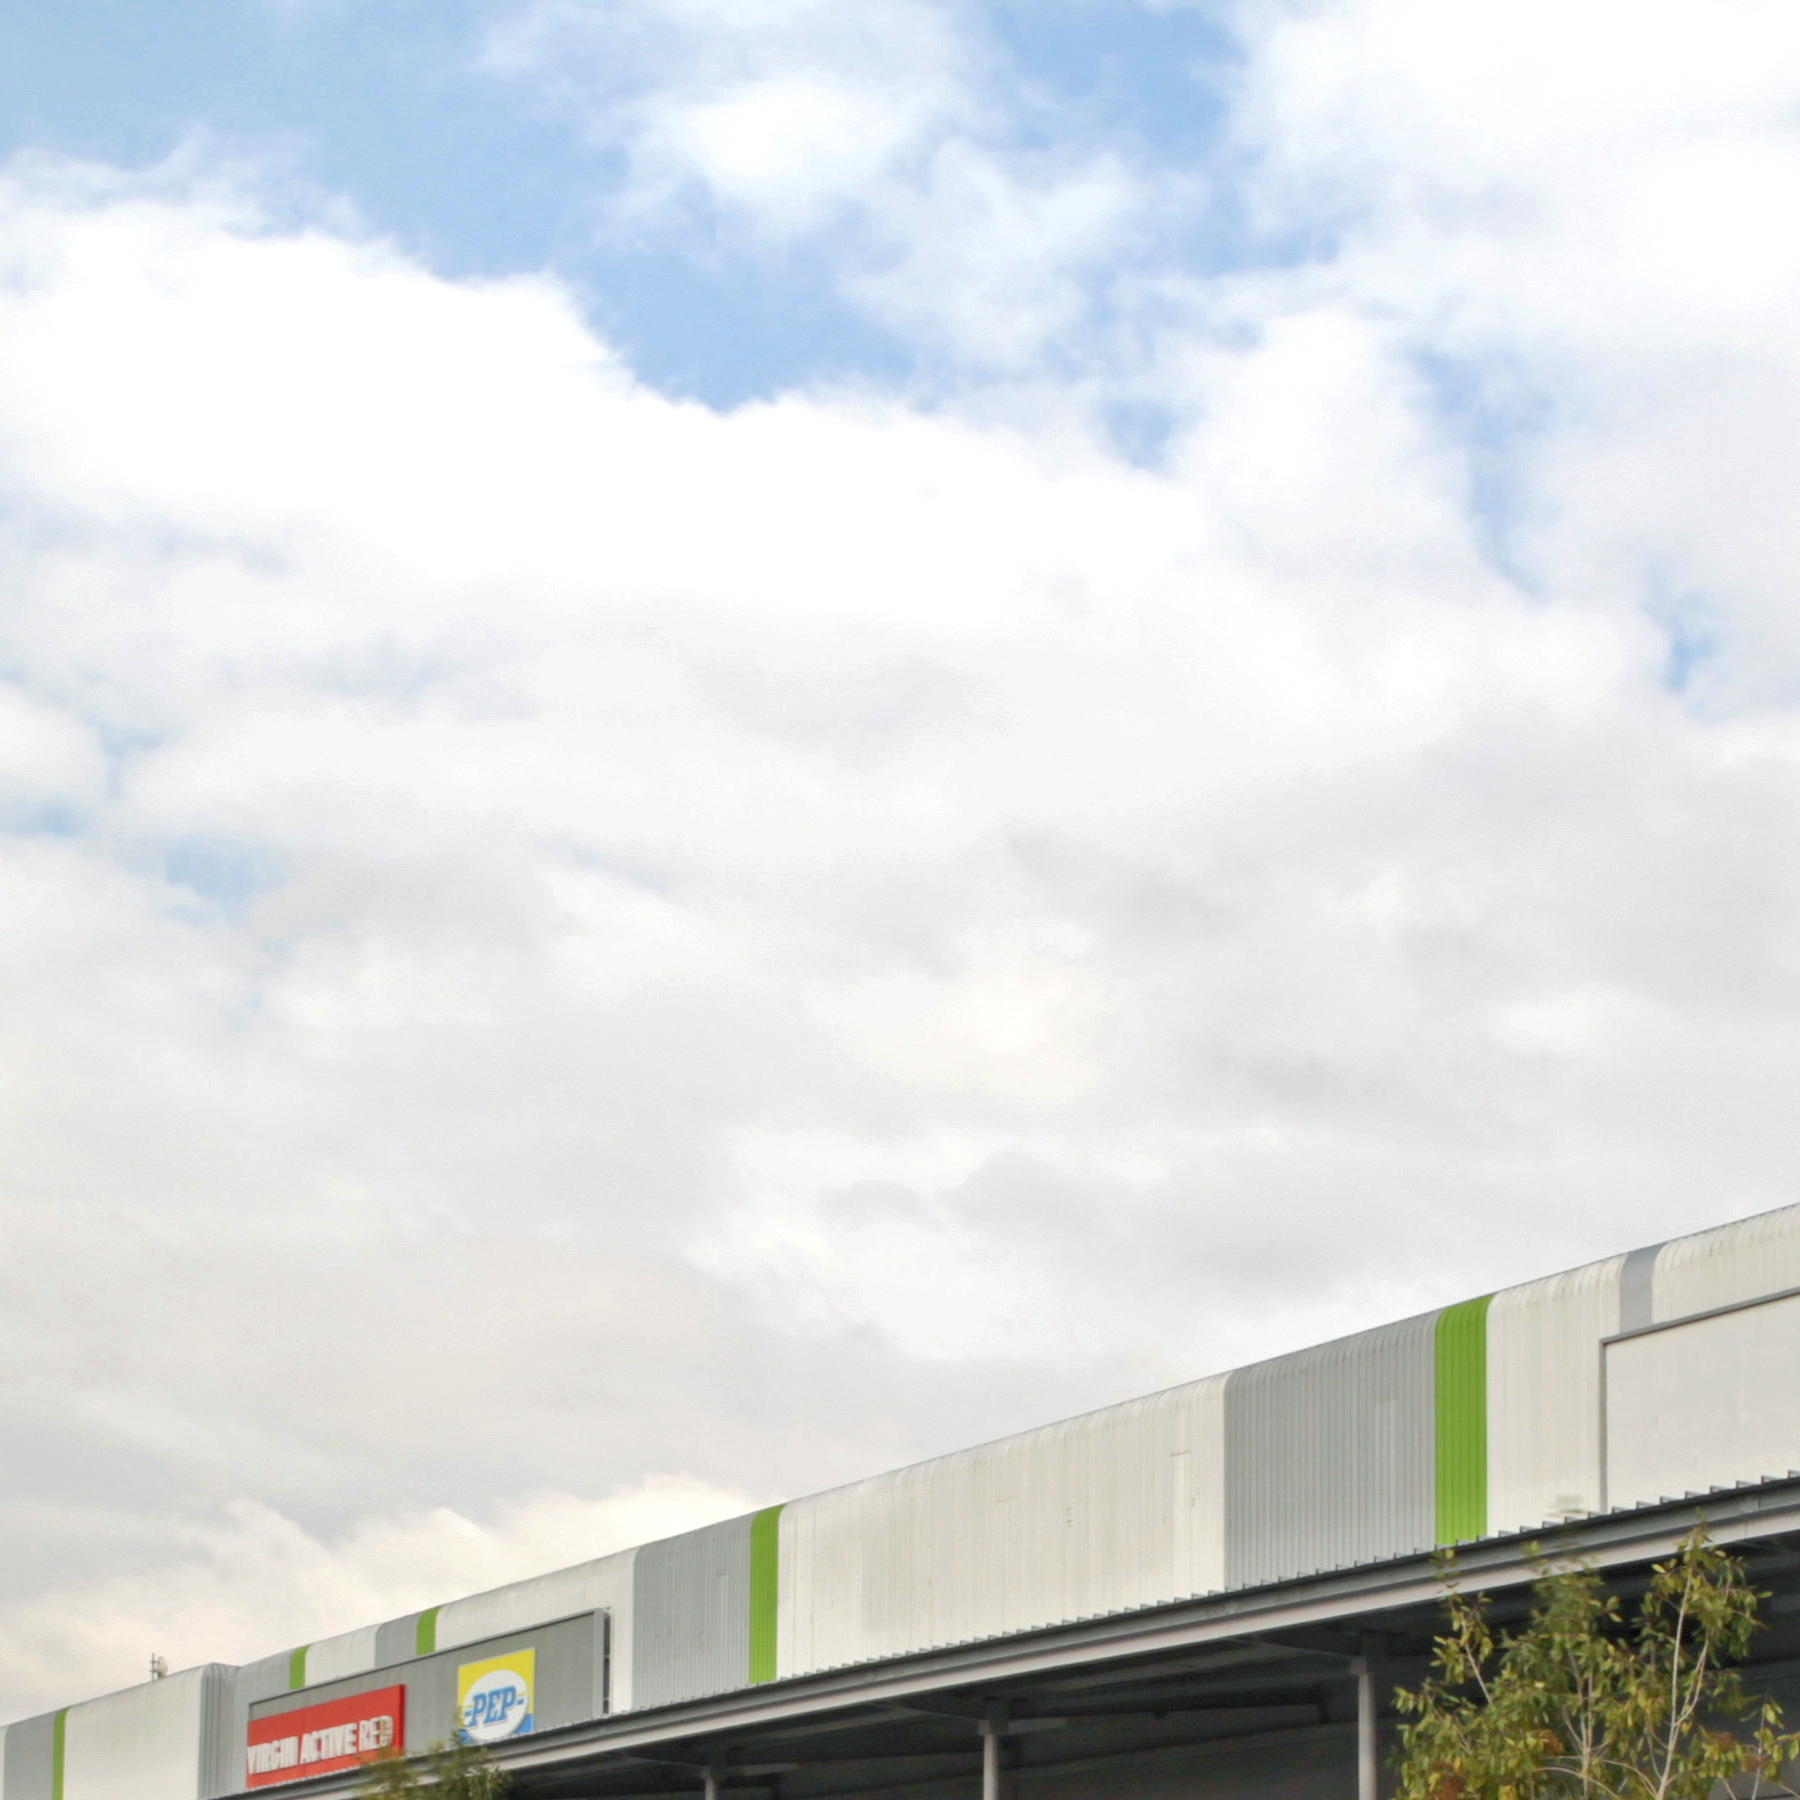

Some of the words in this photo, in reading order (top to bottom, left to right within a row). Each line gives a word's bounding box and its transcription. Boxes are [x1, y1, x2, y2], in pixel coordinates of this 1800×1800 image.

[468, 1685, 516, 1727] PEP
[247, 1736, 298, 1774] VIRGIN
[300, 1722, 357, 1764] ACTIVE
[359, 1714, 393, 1751] RED
